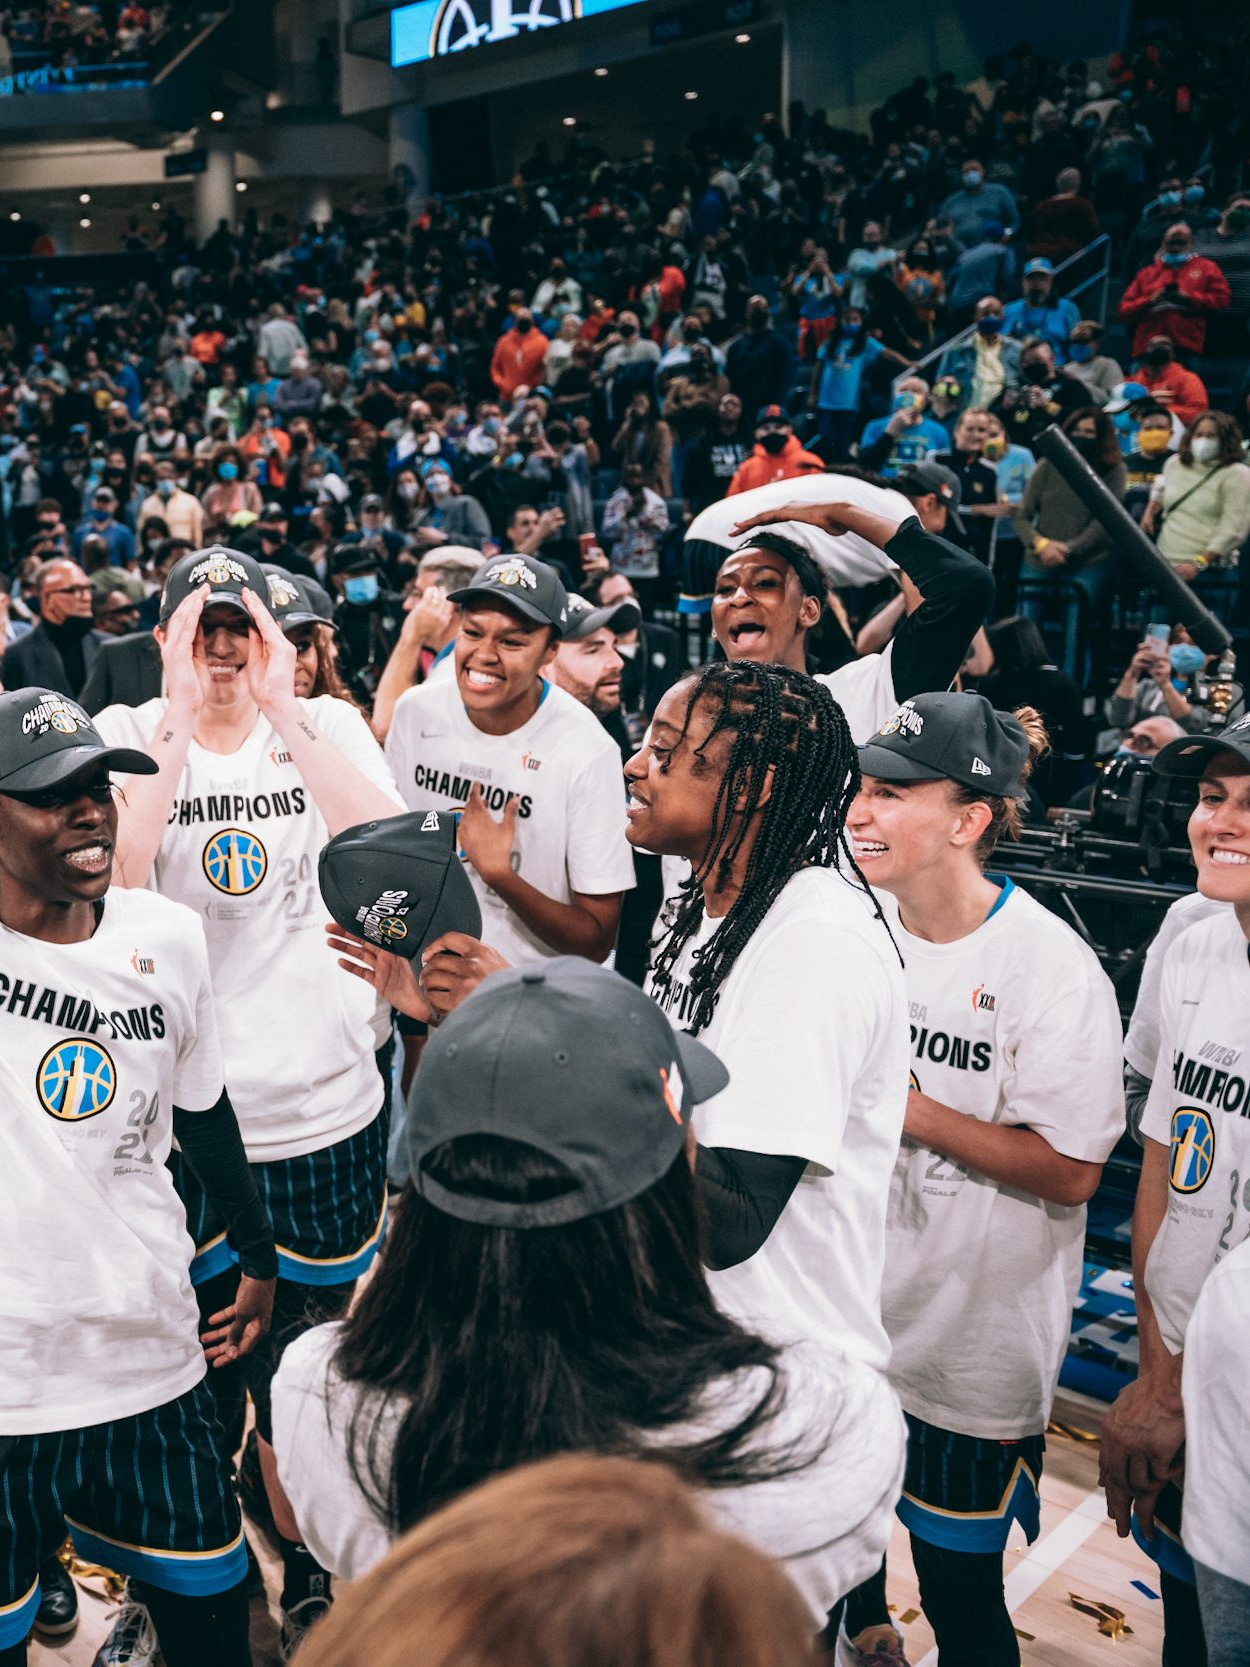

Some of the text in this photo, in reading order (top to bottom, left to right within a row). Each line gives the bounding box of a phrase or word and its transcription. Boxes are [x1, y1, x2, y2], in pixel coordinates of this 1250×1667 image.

[188, 558, 249, 583] CHAMPIONS
[458, 762, 493, 781] WNBA
[280, 853, 312, 887] 20
[126, 1089, 159, 1127] 20
[113, 1128, 154, 1165] 21
[922, 1188, 956, 1197] FINALS
[1191, 1207, 1214, 1219] SKY
